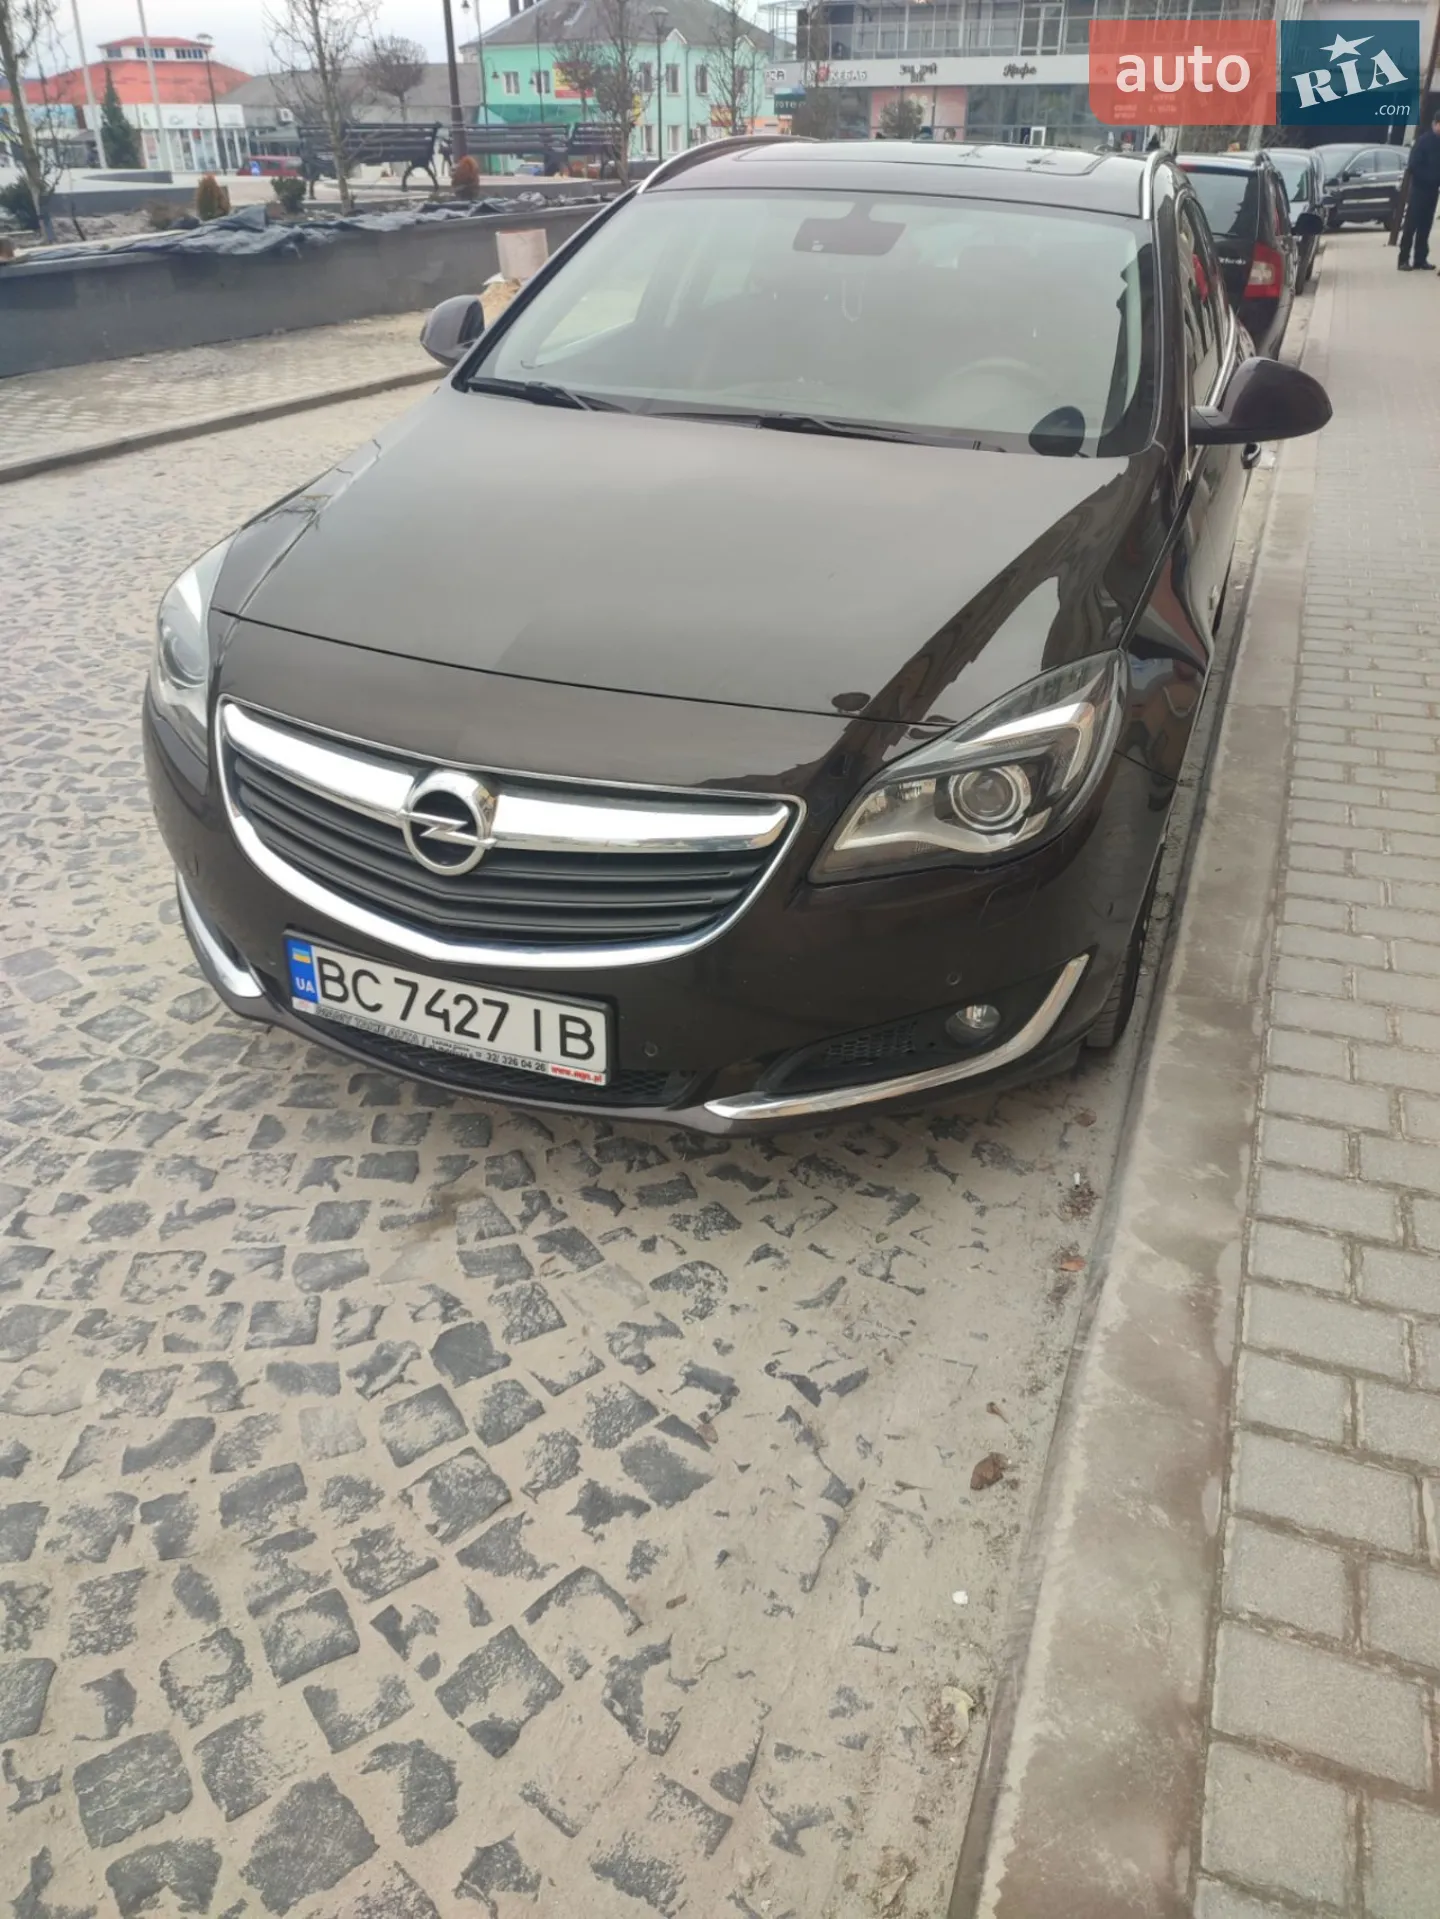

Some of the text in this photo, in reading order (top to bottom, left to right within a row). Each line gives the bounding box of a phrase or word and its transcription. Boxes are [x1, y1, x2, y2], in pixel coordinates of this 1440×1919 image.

[295, 976, 316, 994] UA
[316, 956, 383, 1013] BC
[393, 976, 510, 1043] 7427
[533, 1008, 596, 1061] IB
